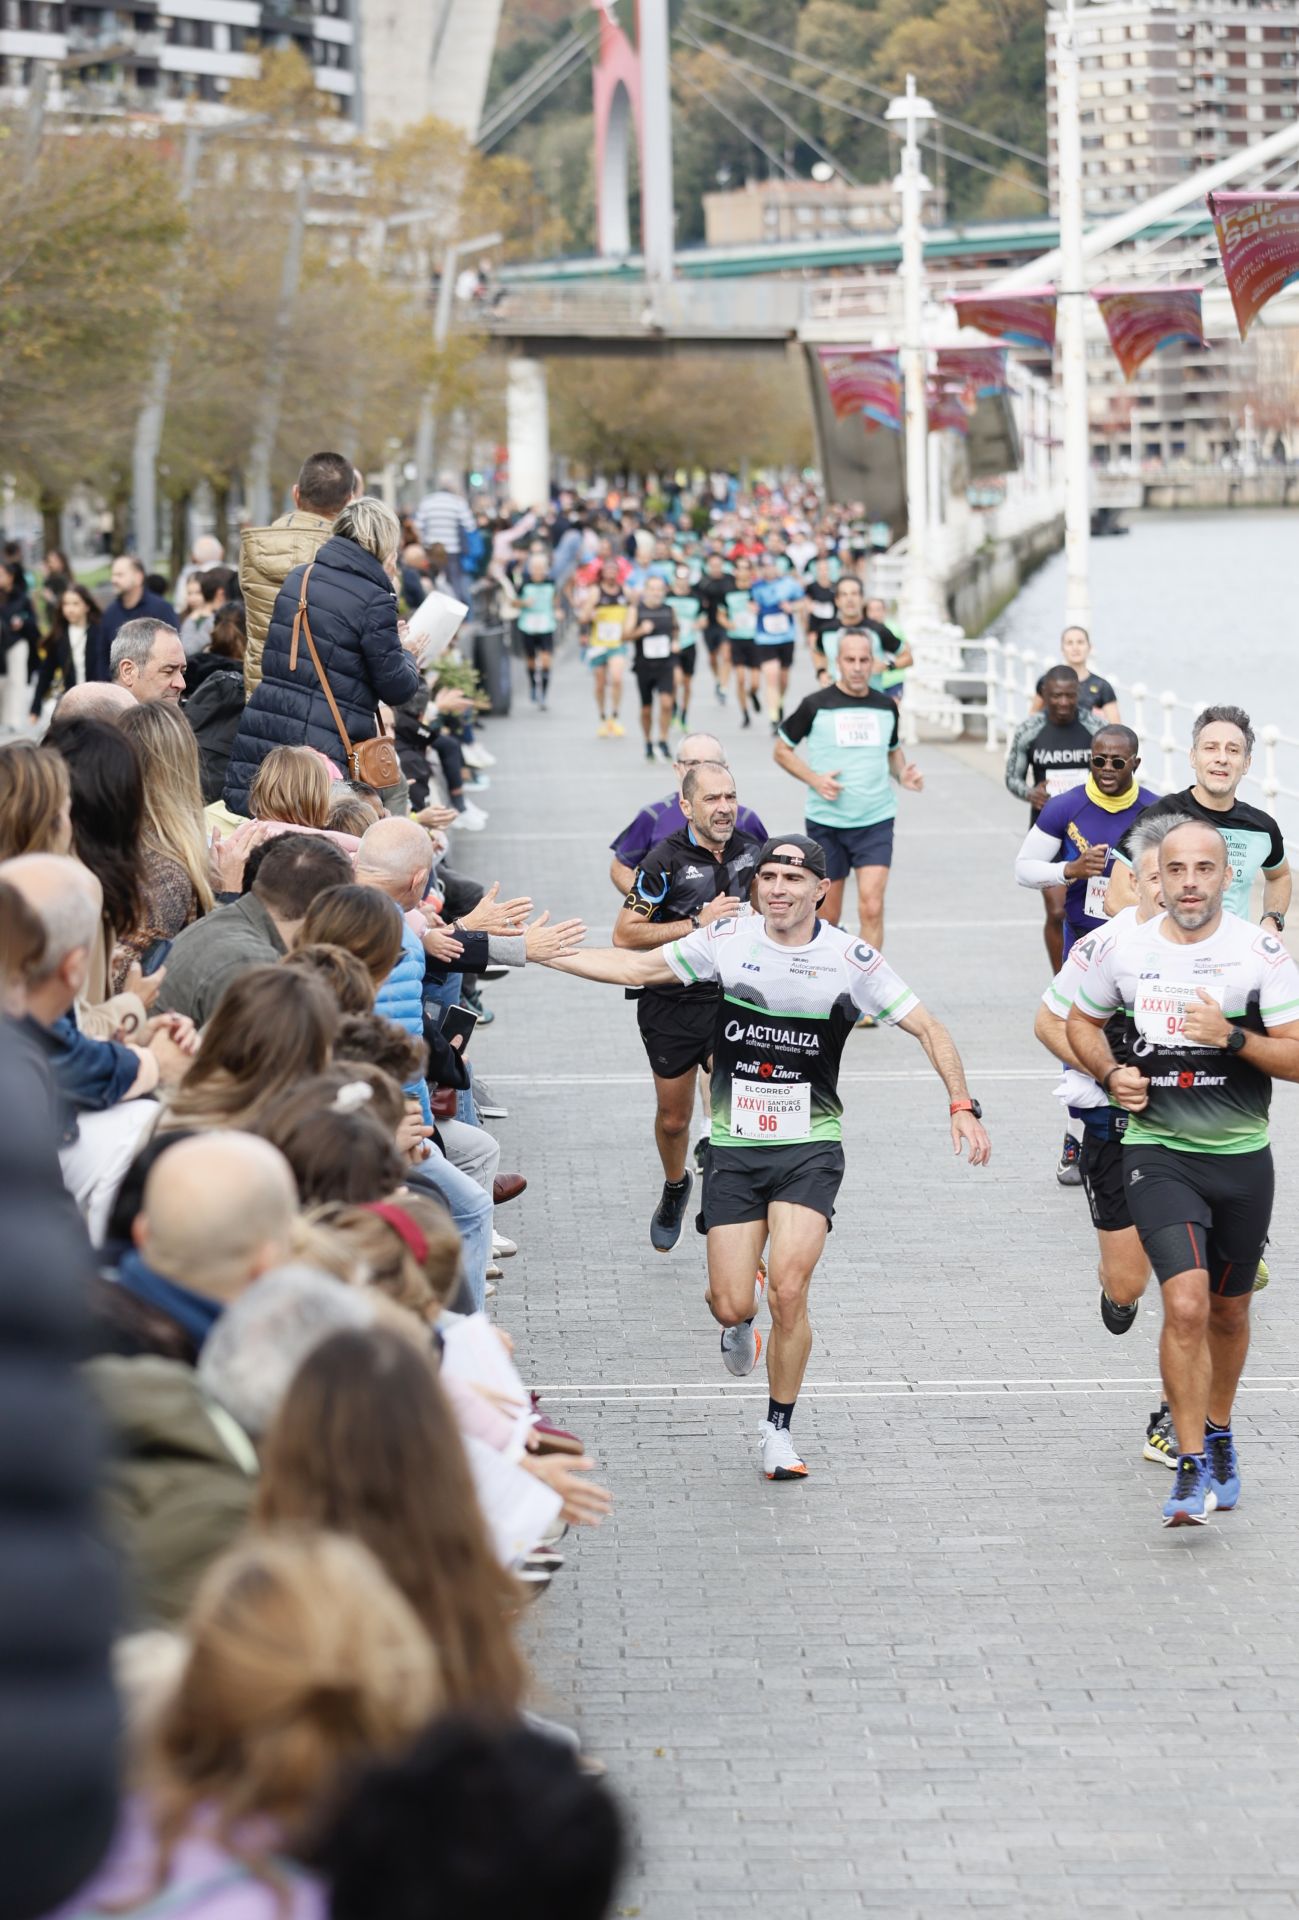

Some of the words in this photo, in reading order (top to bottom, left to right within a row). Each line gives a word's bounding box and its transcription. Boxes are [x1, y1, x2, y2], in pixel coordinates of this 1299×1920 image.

[1221, 201, 1278, 234] Fair
[1091, 888, 1106, 898] XXX
[1079, 939, 1097, 962] A
[1262, 936, 1280, 954] C
[854, 944, 874, 962] C
[742, 962, 760, 972] LEA
[1165, 987, 1196, 996] CORRE
[1141, 998, 1174, 1013] XXXVI
[746, 1024, 819, 1048] ACTUALIZA
[746, 1039, 770, 1049] software
[775, 1044, 801, 1053] websites
[736, 1061, 758, 1074] PAIN
[772, 1070, 802, 1080] LIMIT
[1151, 1076, 1178, 1086] PAIN
[1193, 1076, 1227, 1086] LIMIT
[737, 1096, 765, 1111] XXXVI
[736, 1124, 743, 1135] k
[759, 1115, 777, 1132] 96
